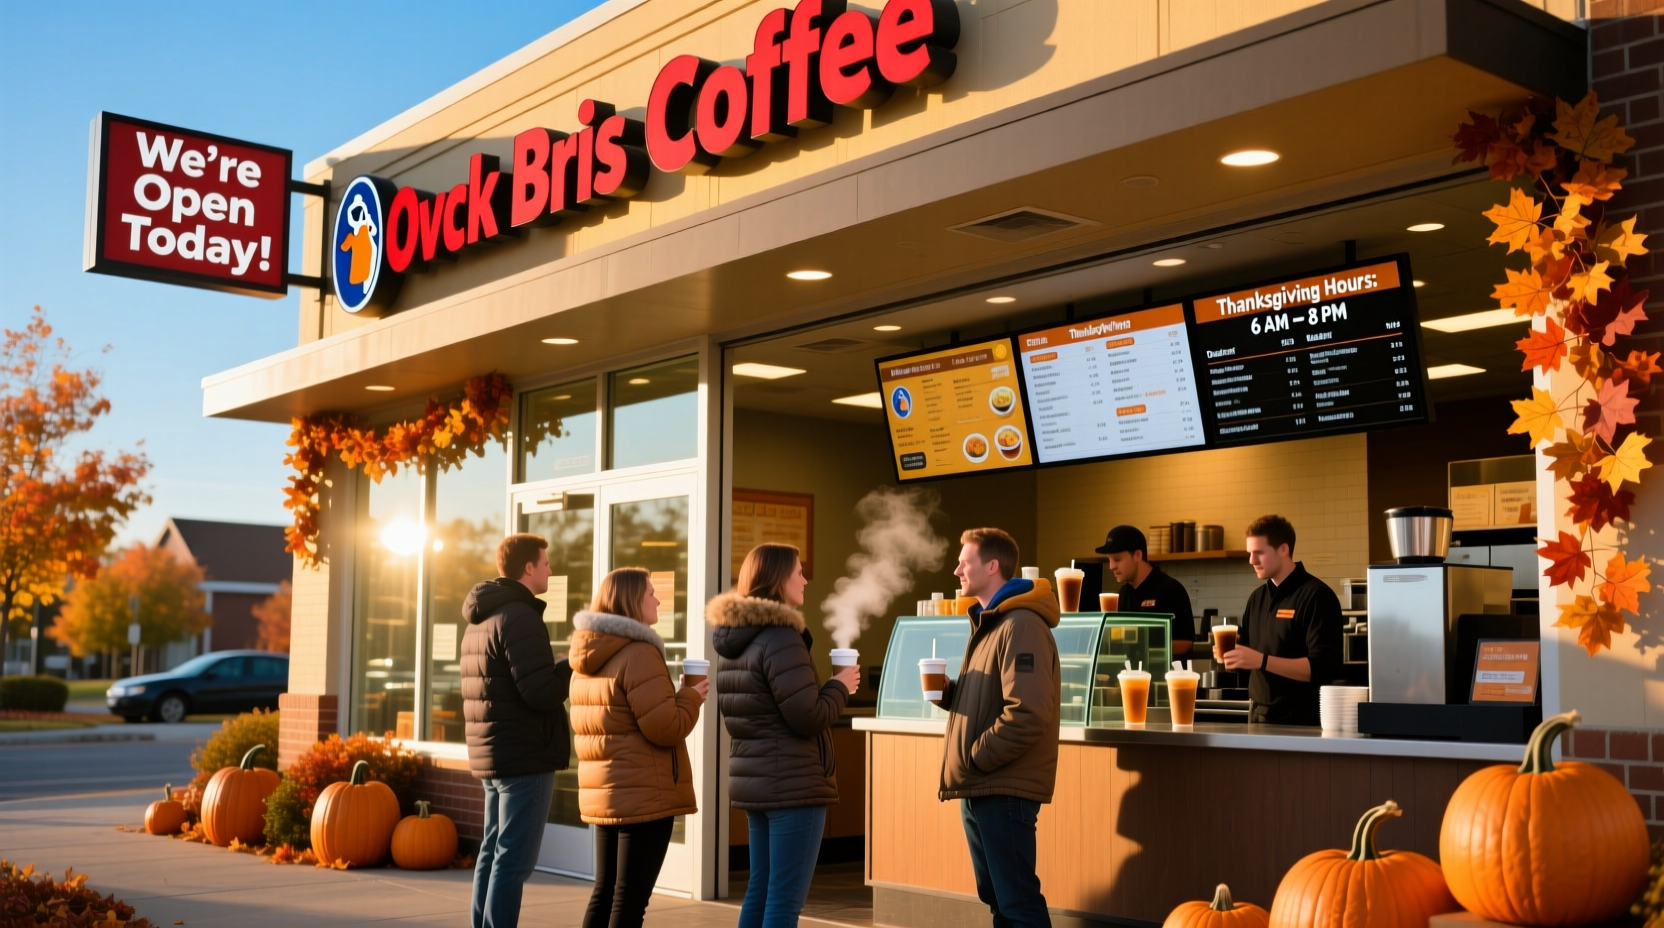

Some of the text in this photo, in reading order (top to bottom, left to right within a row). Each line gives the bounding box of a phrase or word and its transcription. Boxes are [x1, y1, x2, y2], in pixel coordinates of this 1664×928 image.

[386, 0, 935, 273] Ovck Bris Coffee
[133, 173, 255, 227] Open
[121, 212, 272, 276] Today!
[1216, 273, 1378, 316] Thanksgiving Hours:
[1250, 317, 1262, 335] 6
[1264, 313, 1290, 333] AM
[1308, 308, 1319, 325] 8
[1321, 302, 1348, 323] PM
